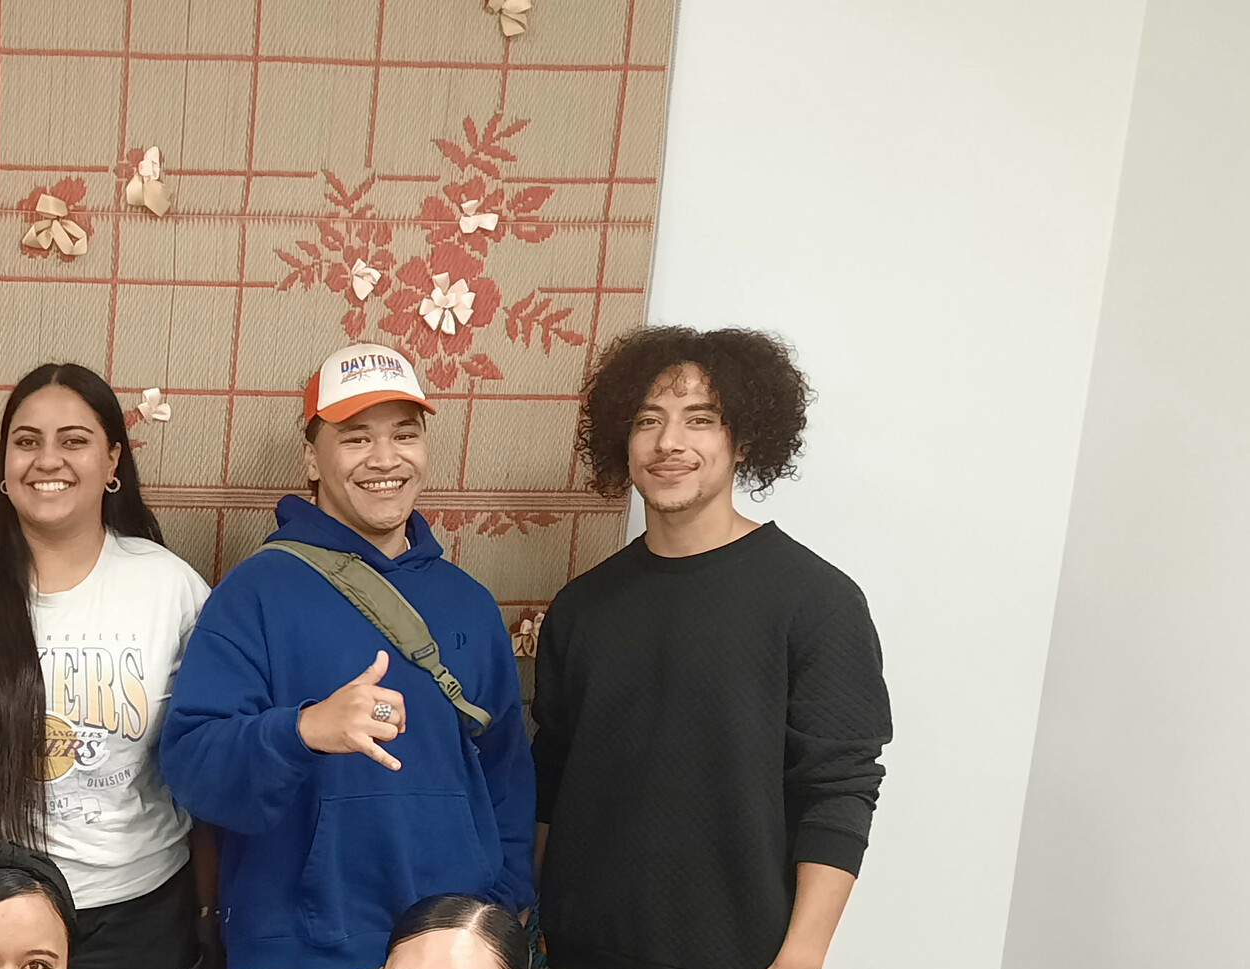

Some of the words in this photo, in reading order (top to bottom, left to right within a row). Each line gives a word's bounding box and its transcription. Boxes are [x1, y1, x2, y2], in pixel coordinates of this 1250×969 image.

[341, 355, 403, 373] DAYTONA
[46, 633, 137, 642] NGELES
[44, 738, 103, 767] ERS
[86, 769, 132, 788] DIVISION
[49, 797, 69, 811] 947
